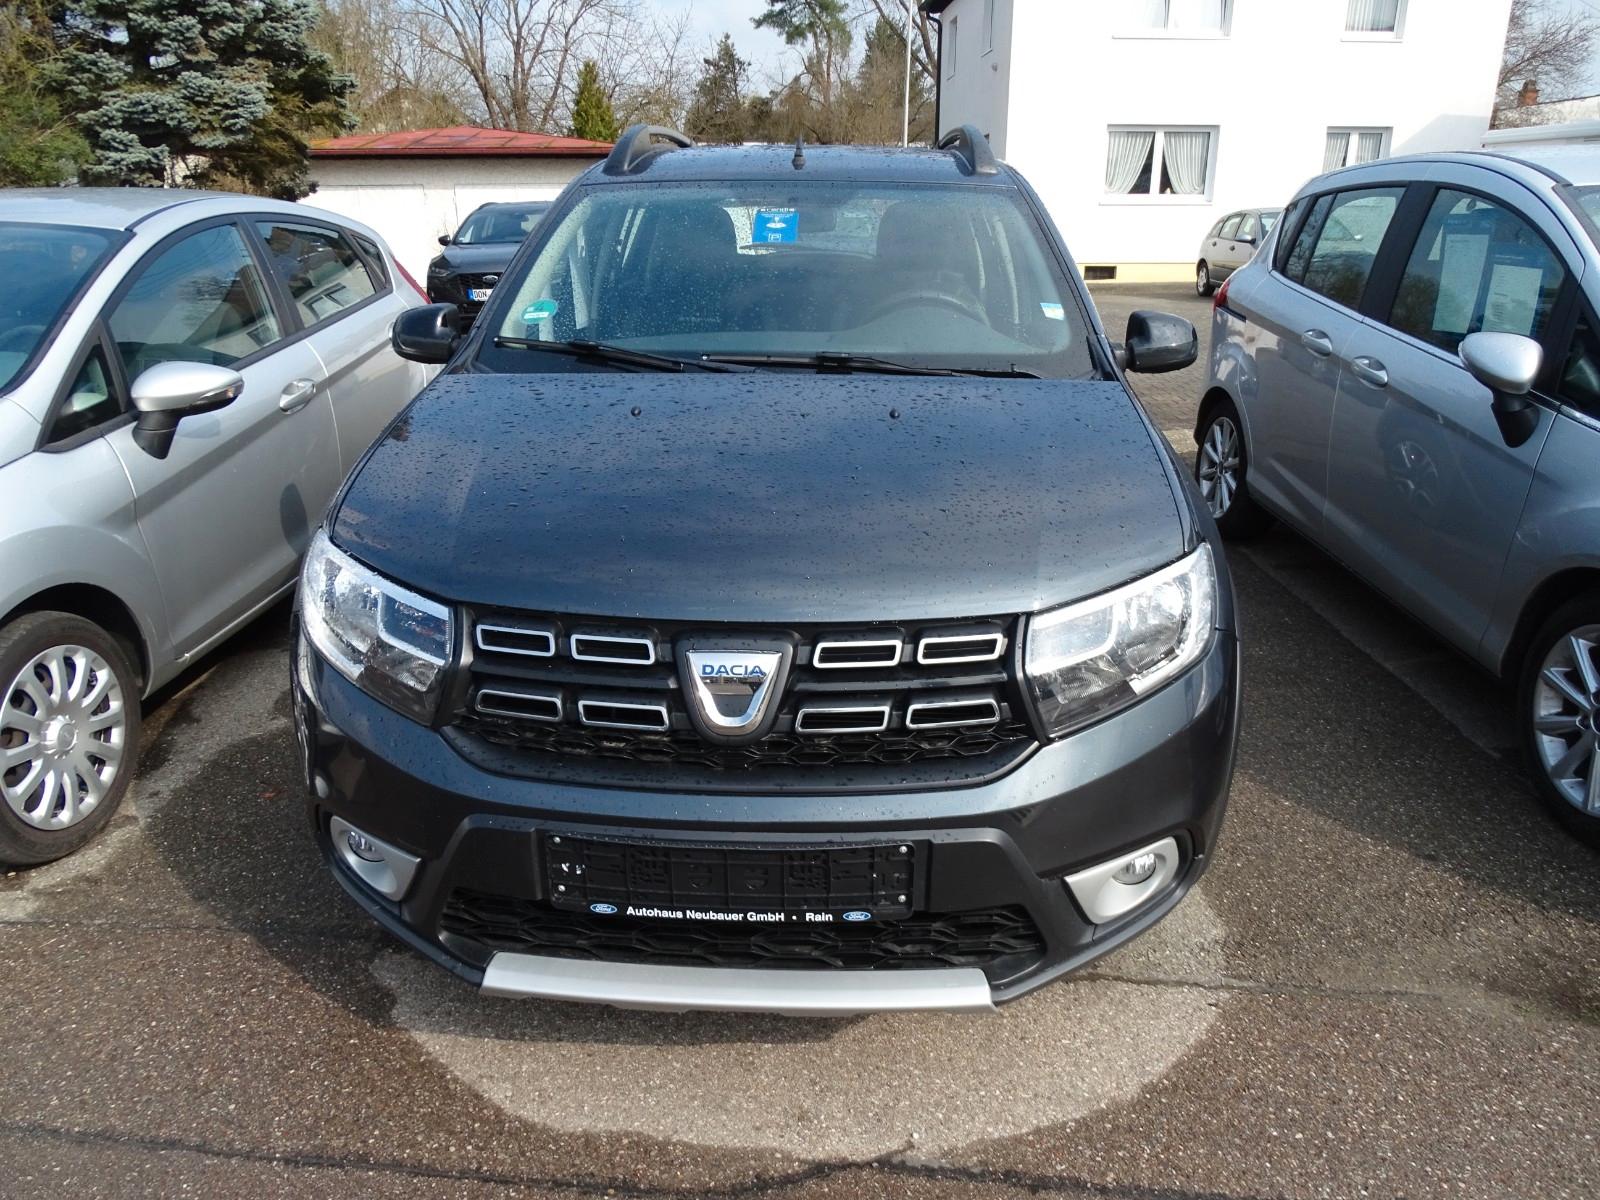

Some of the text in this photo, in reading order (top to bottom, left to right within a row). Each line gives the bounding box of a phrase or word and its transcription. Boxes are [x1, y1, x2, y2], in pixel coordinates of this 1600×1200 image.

[701, 664, 767, 676] DACIA
[593, 903, 614, 913] Ford
[626, 906, 833, 922] Autohaus Neubauer GmbH Rain
[846, 911, 868, 920] Ford
